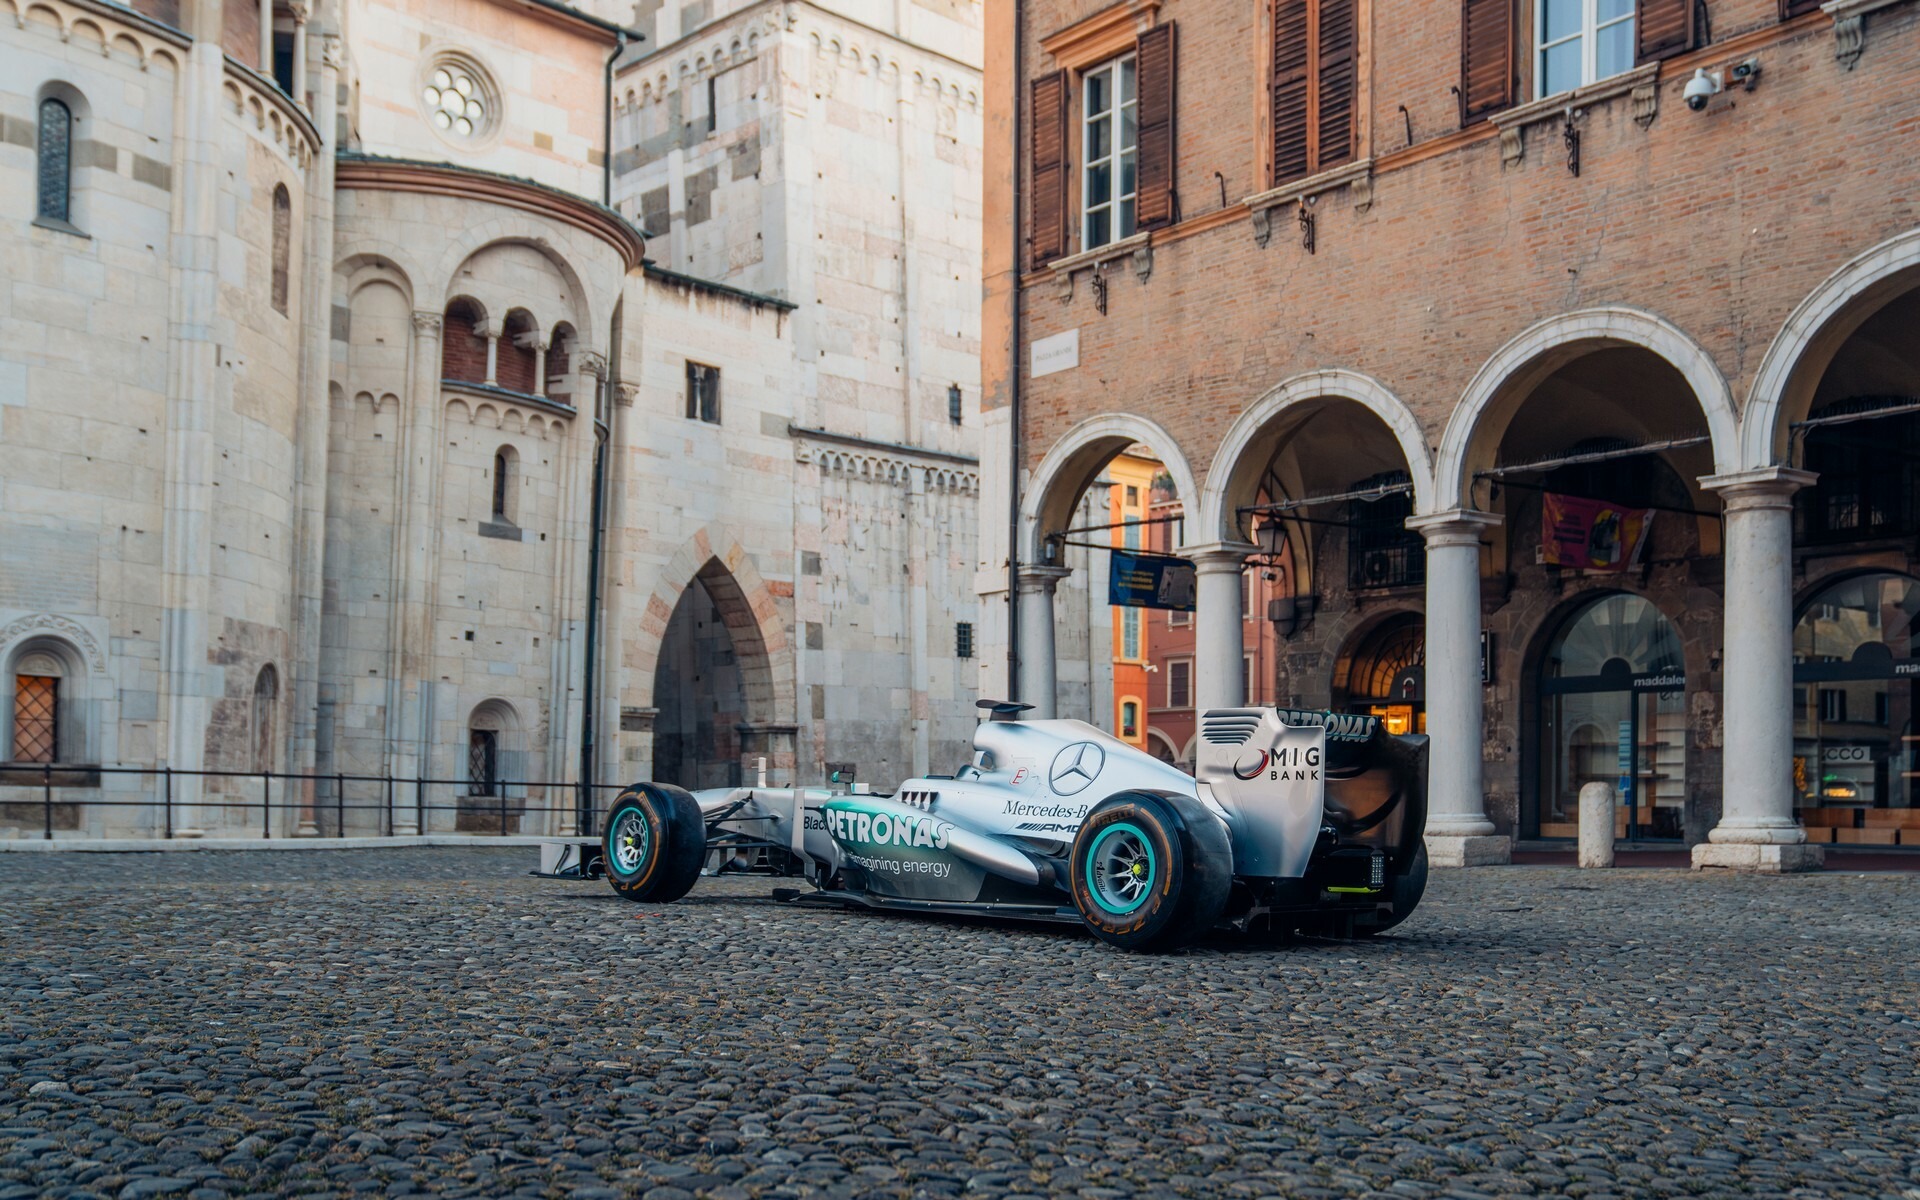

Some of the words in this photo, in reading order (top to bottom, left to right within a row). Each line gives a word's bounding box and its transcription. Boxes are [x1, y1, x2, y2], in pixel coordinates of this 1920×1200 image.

[1895, 664, 1920, 673] ma
[1270, 747, 1319, 767] MIG
[1270, 770, 1319, 780] BANK
[804, 816, 827, 830] Blac
[826, 808, 955, 850] PETRONAS
[902, 861, 951, 878] energy
